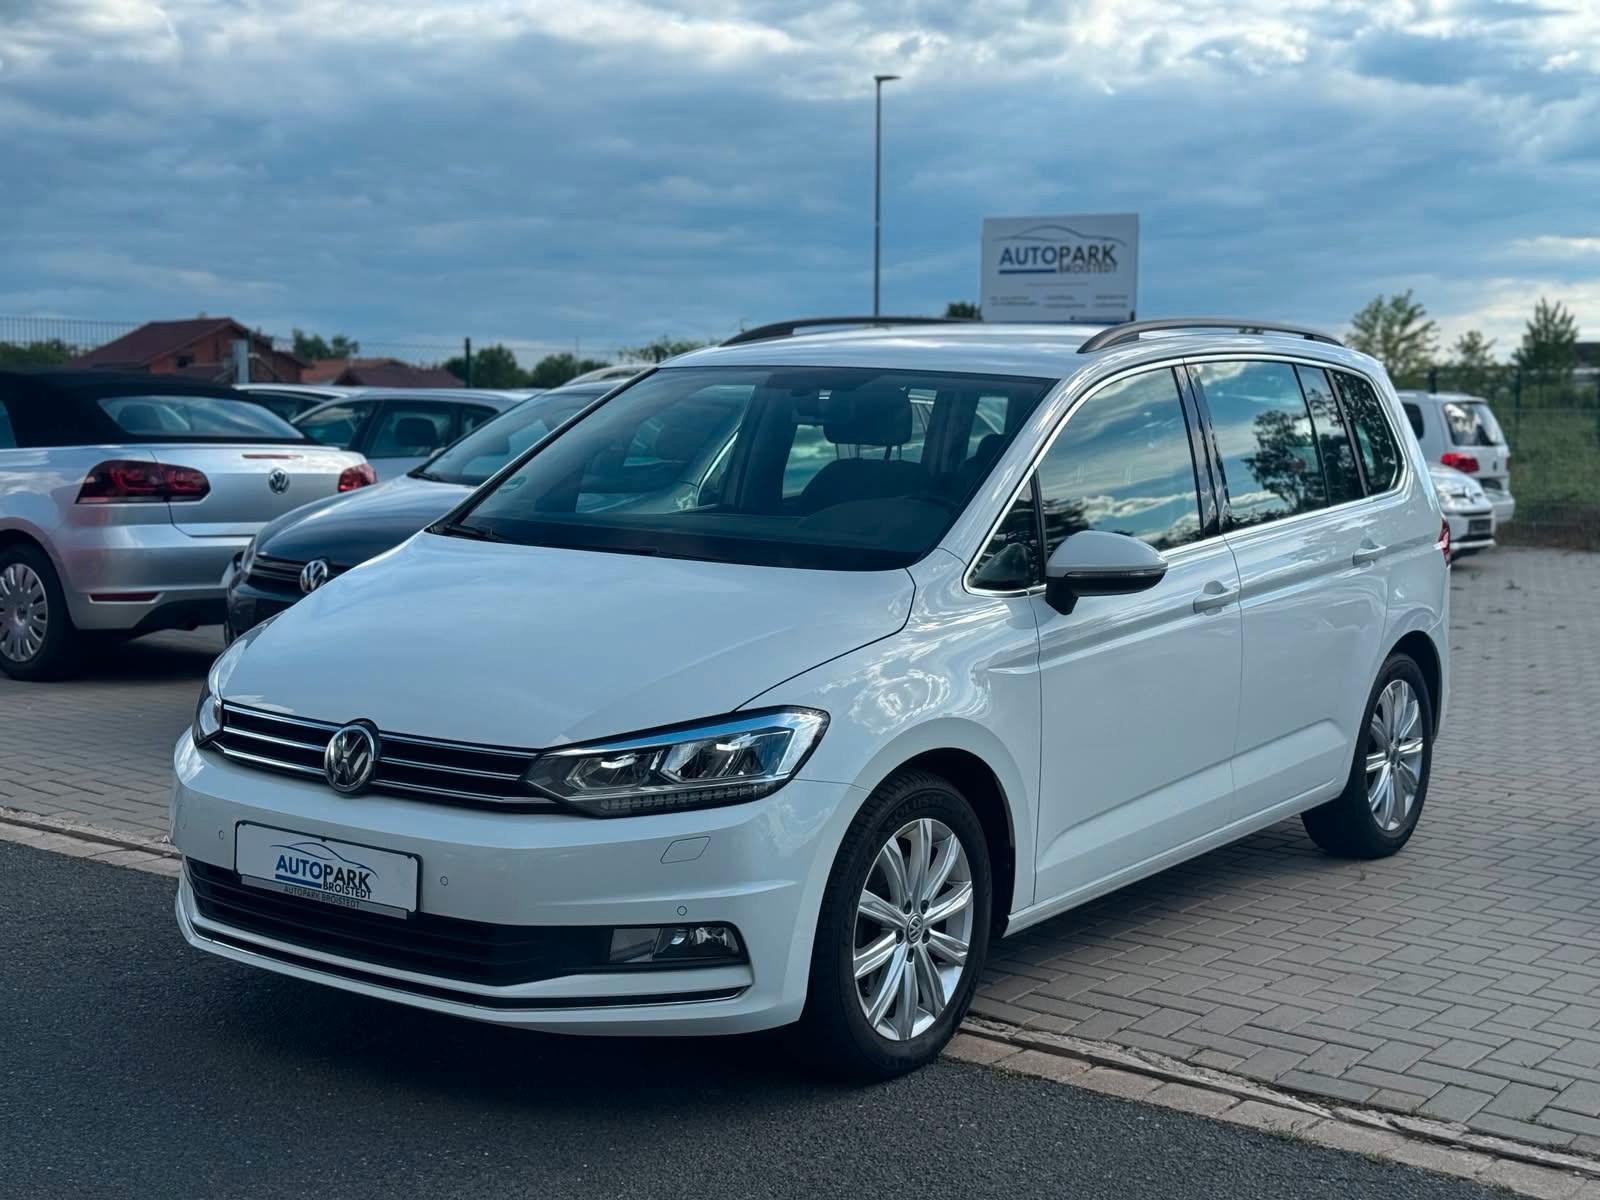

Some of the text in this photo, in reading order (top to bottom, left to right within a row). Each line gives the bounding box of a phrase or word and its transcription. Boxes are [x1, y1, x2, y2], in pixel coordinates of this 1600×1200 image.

[1000, 244, 1118, 266] AUTOPARK
[275, 854, 371, 893] AUTOPARK
[284, 886, 360, 910] AUTOPARK BROISTEDT
[322, 881, 372, 899] BROISTEDT
